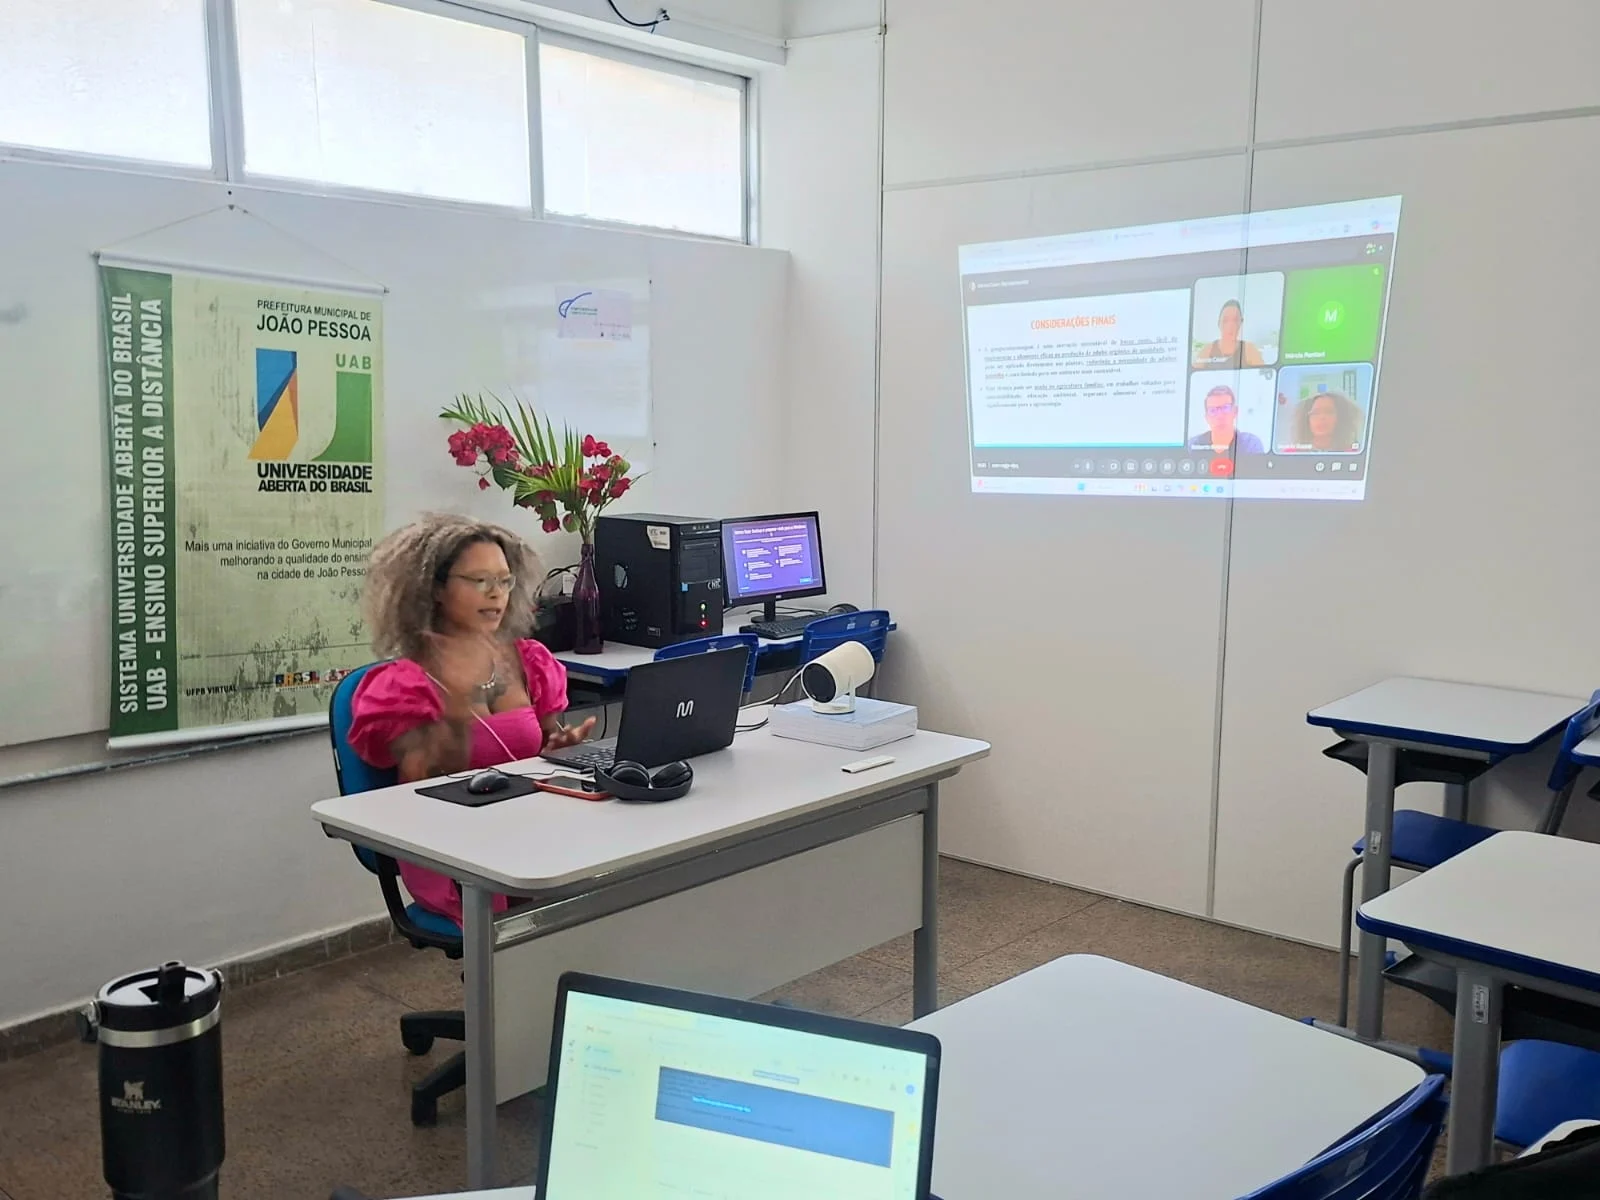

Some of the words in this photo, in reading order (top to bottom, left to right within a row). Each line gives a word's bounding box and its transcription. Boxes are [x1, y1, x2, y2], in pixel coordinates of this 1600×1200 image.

[257, 299, 312, 314] PREFEITURA
[314, 306, 358, 320] MUNICIPAL
[360, 311, 372, 321] DE
[1325, 310, 1337, 322] M
[112, 294, 132, 363] BRASIL
[256, 314, 303, 334] JOÃO
[308, 319, 371, 342] PESSOA
[1031, 315, 1089, 329] CONSIDERAÇÕES
[1091, 314, 1116, 326] FINAIS
[136, 299, 163, 417] DISTÂNCIA
[335, 353, 372, 370] UAB
[113, 370, 132, 396] DO
[114, 403, 133, 477] ABERTA
[143, 426, 163, 439] A
[257, 462, 373, 480] UNIVERSIDADE
[258, 479, 306, 492] ABERTA
[309, 480, 327, 492] DO
[330, 480, 373, 493] BRASIL
[143, 447, 165, 556] SUPERIOR
[117, 483, 137, 623] UNIVERSIDADE
[185, 540, 209, 552] Mais
[212, 542, 233, 551] uma
[235, 539, 275, 550] iniciativa
[277, 539, 289, 550] do
[291, 538, 330, 550] Governo
[332, 537, 372, 550] Municipal
[220, 553, 275, 566] melhorando
[277, 556, 283, 564] a
[285, 552, 329, 565] qualidade
[331, 552, 342, 563] do
[257, 571, 269, 580] na
[271, 569, 301, 580] cidade
[303, 568, 315, 579] de
[317, 567, 338, 578] João
[340, 566, 367, 577] Pesso
[144, 565, 166, 643] ENSINO
[119, 631, 138, 712] SISTEMA
[146, 667, 167, 710] UAB
[186, 687, 206, 697] UFPB
[207, 684, 238, 695] VIRTUAL
